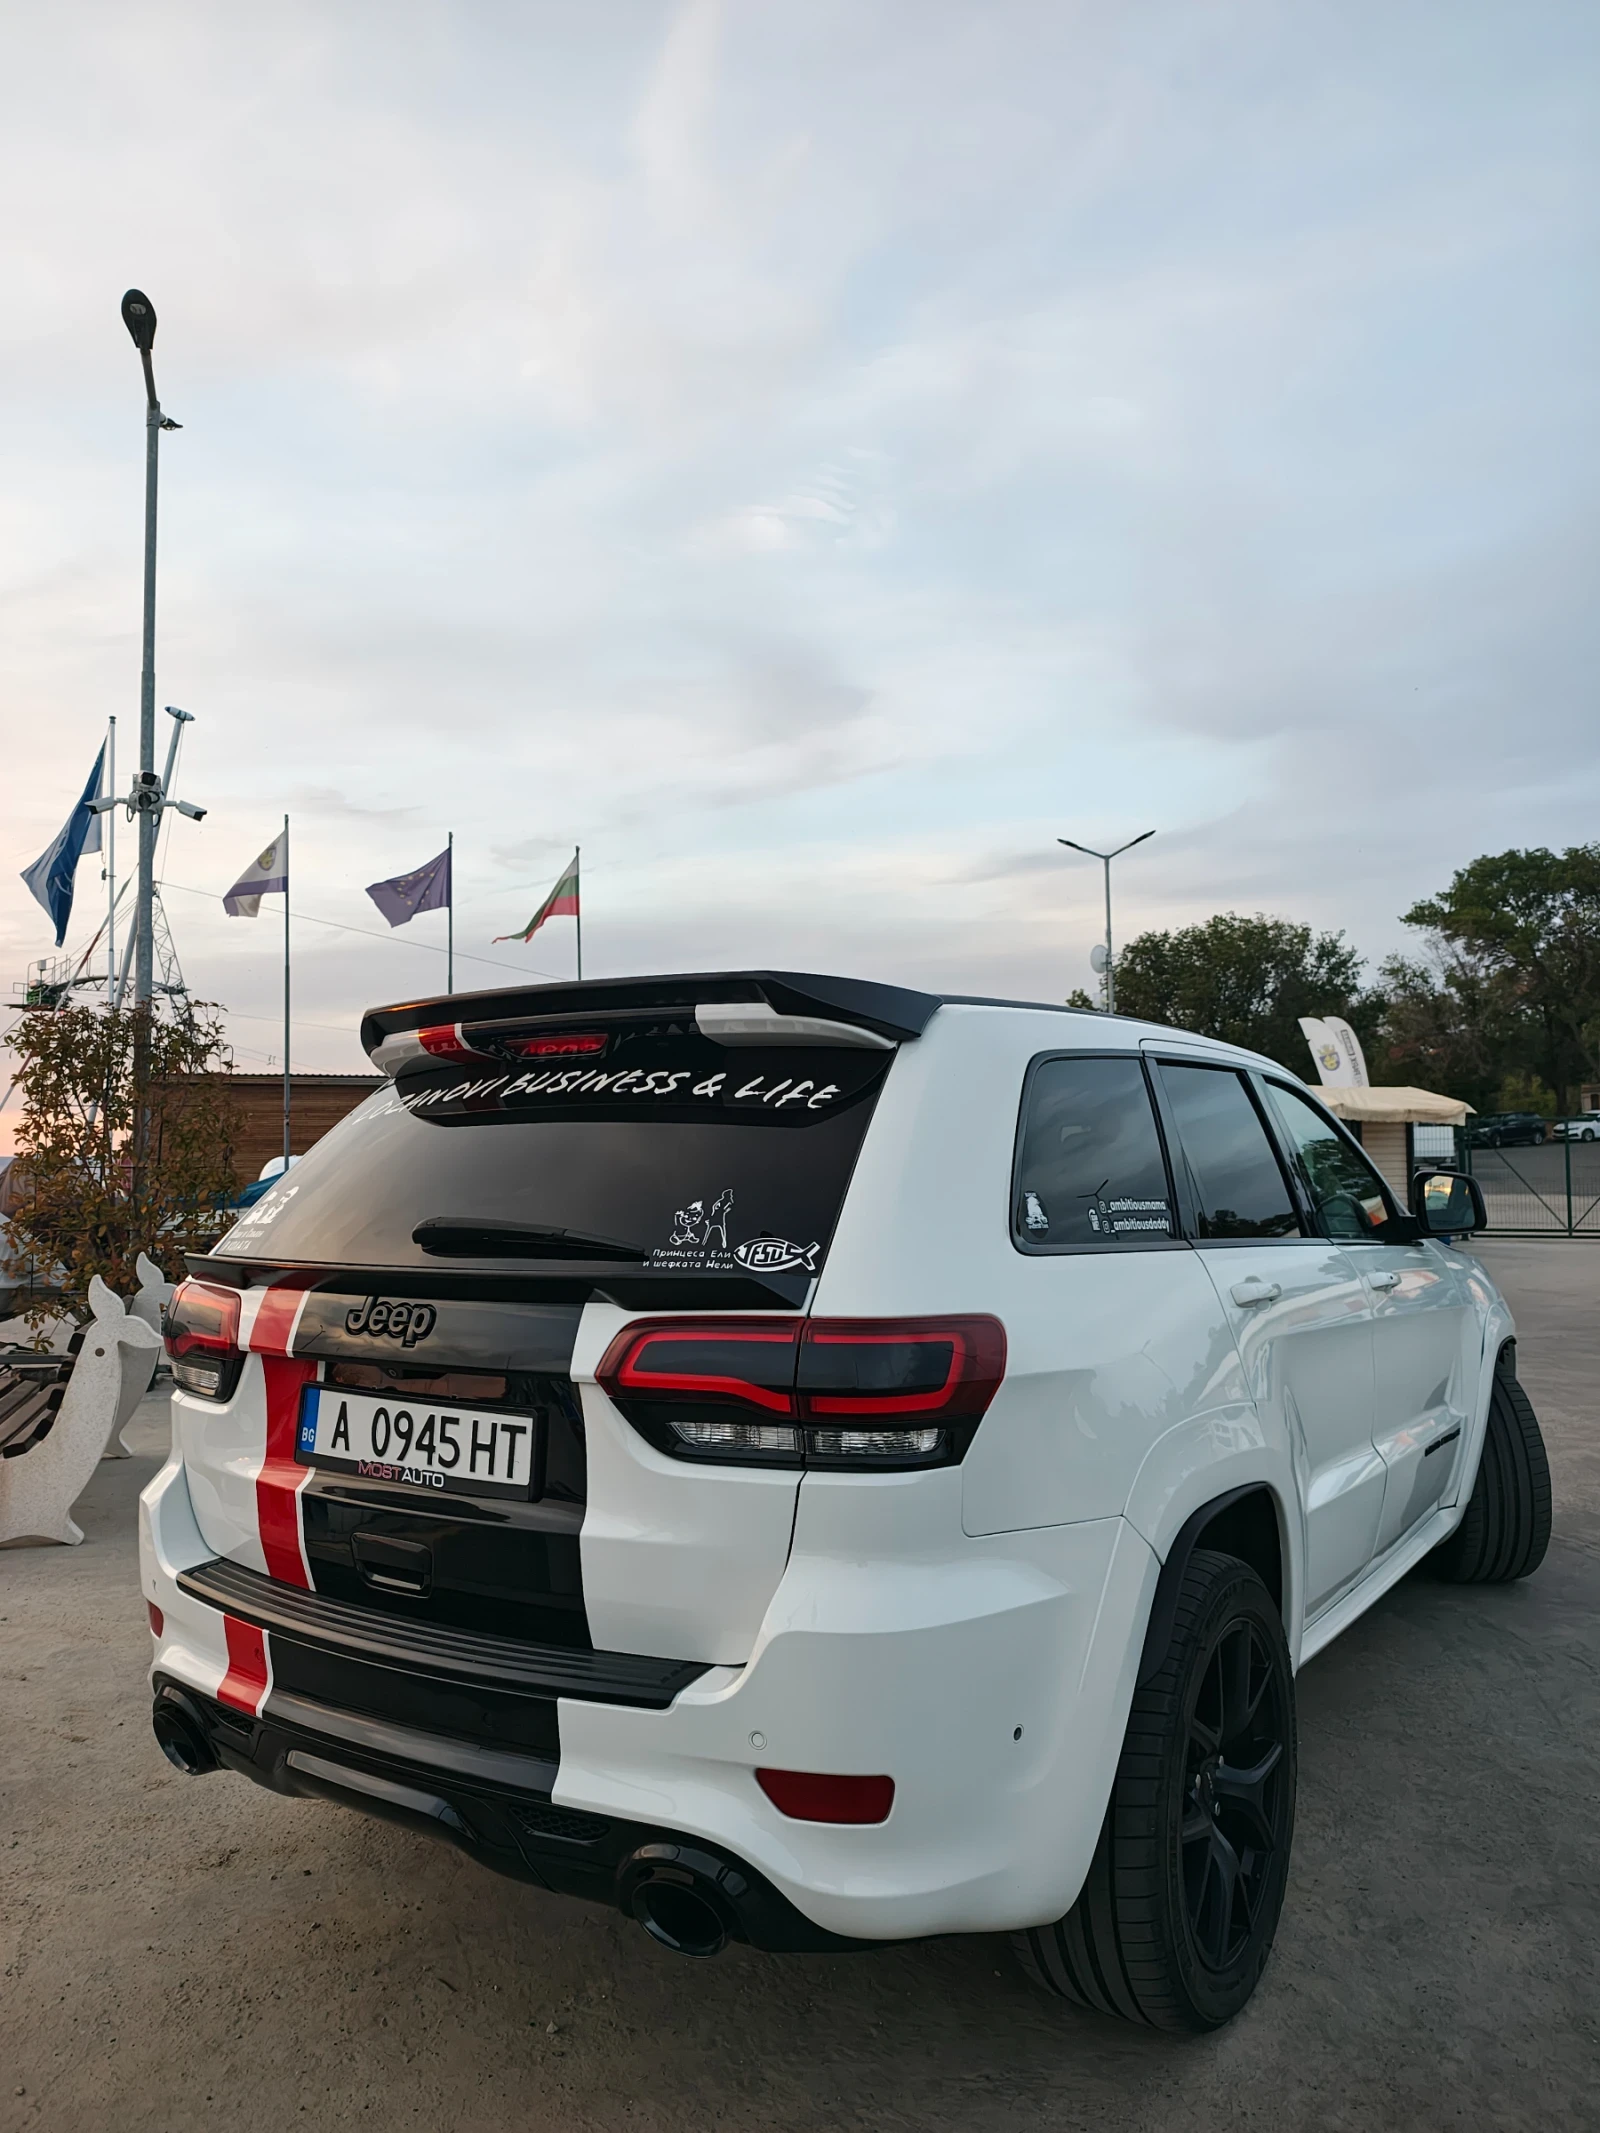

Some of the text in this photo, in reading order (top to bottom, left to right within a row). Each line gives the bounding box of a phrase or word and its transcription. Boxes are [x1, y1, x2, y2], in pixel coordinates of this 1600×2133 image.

[352, 1069, 841, 1125] LOZANOVI BUSINESS & LIFE
[652, 1248, 731, 1259] Принцеса Ели
[653, 1260, 701, 1268] шефката
[706, 1260, 733, 1269] Нели
[346, 1296, 437, 1349] Jeep
[301, 1427, 315, 1444] BG
[331, 1401, 350, 1451] A
[371, 1407, 460, 1468] 0945
